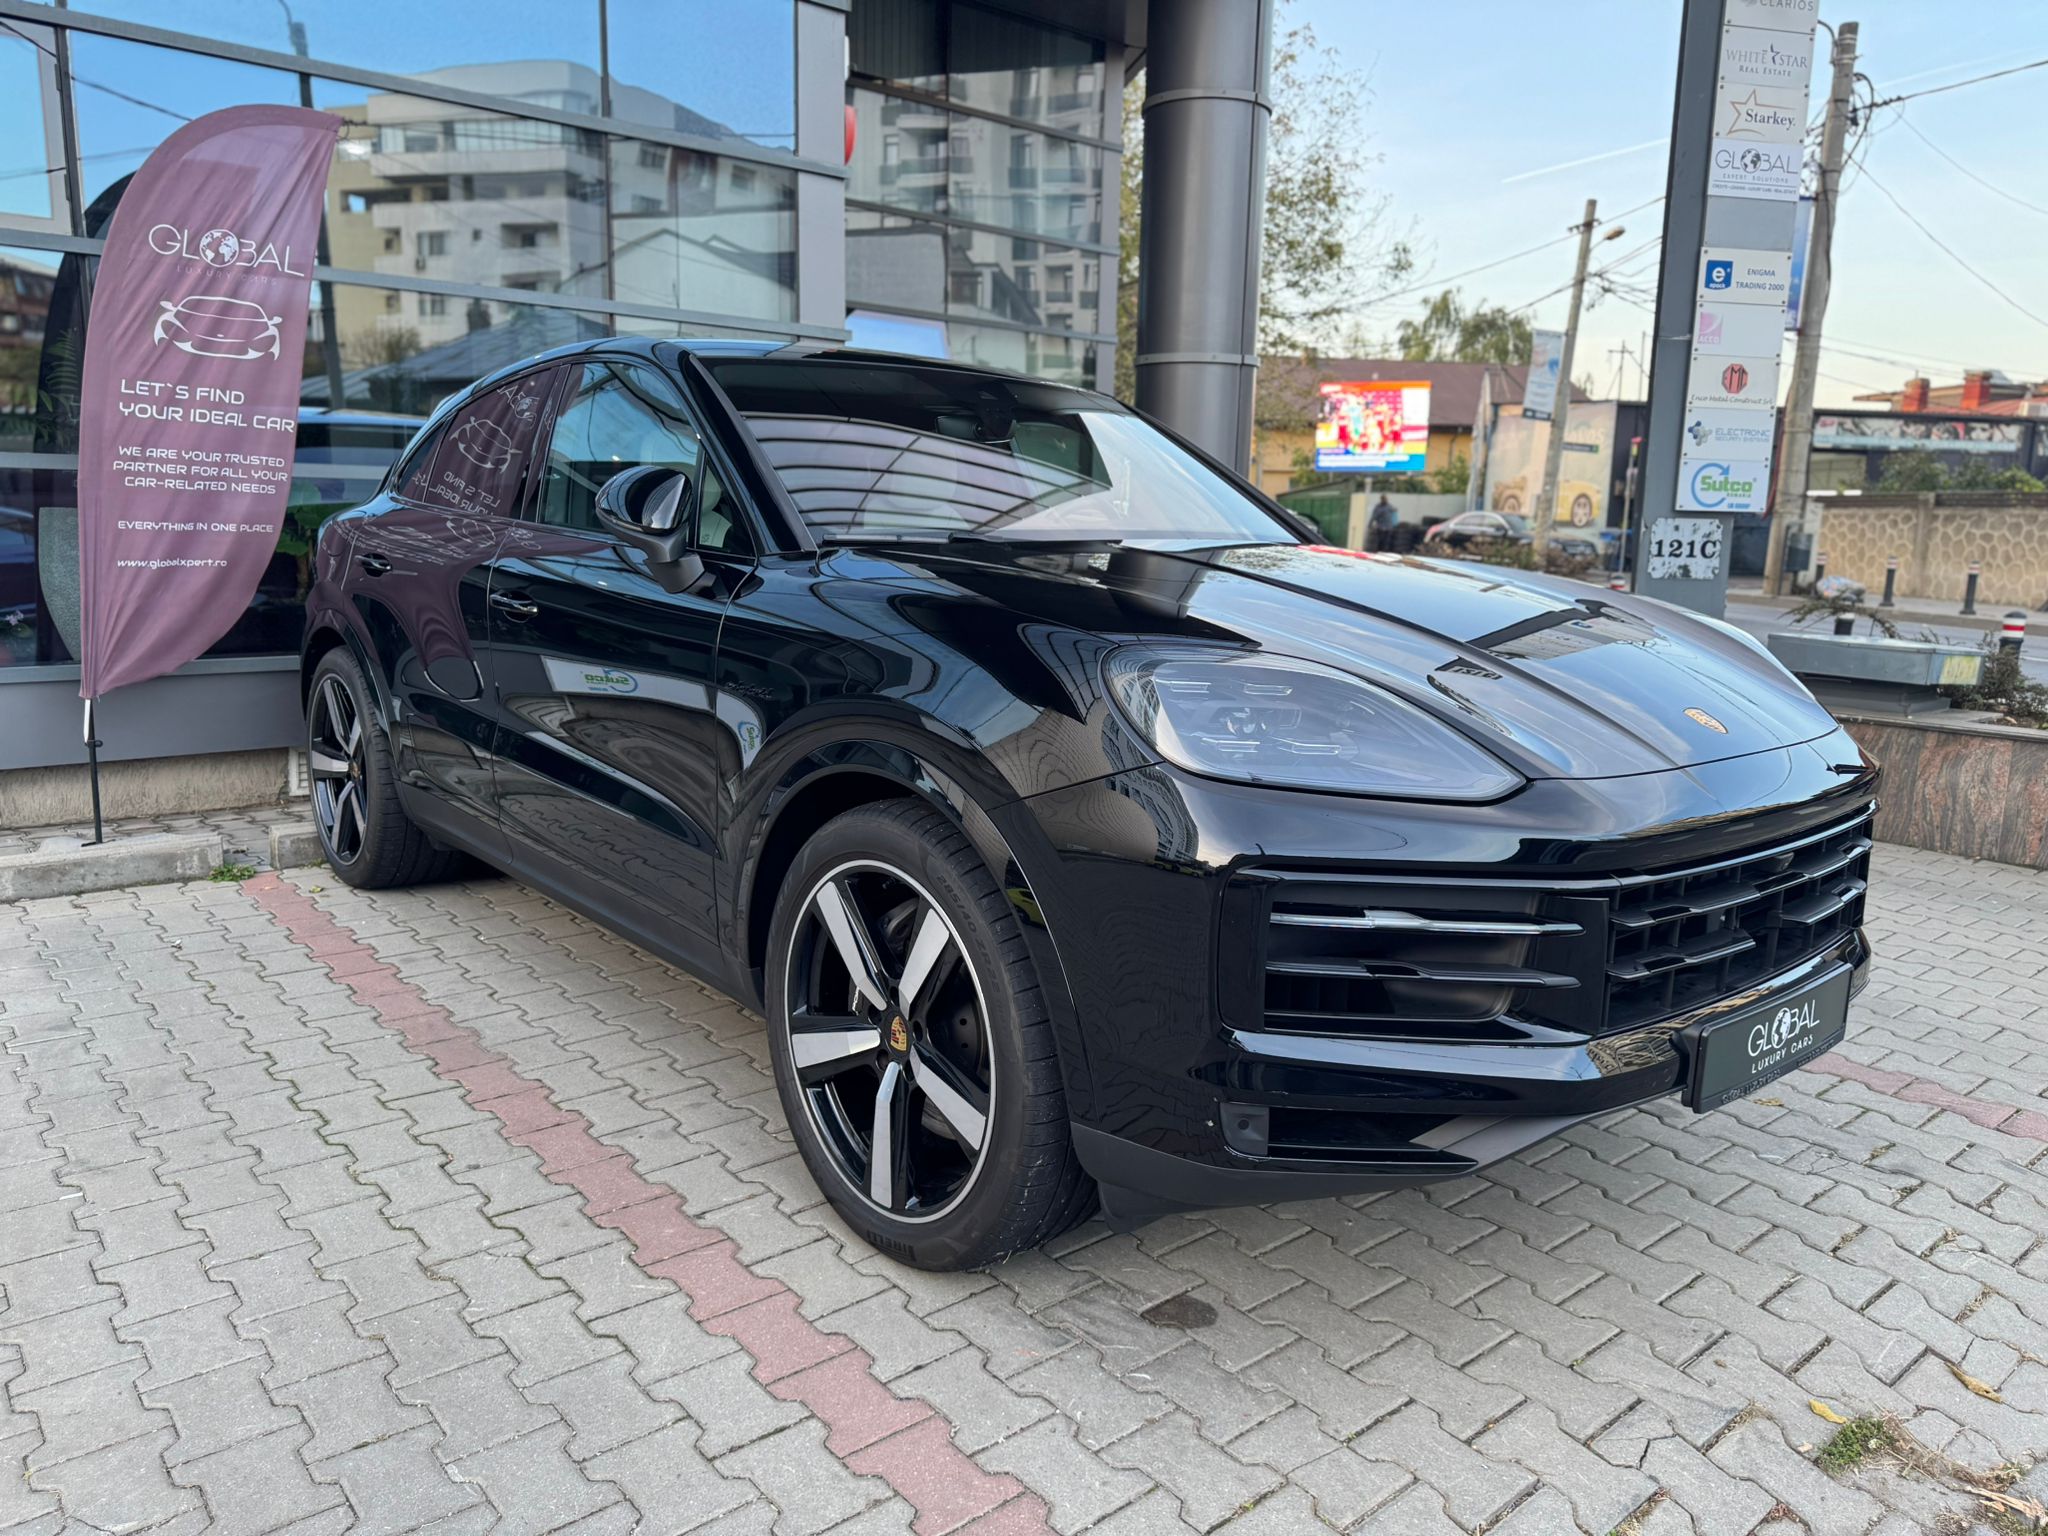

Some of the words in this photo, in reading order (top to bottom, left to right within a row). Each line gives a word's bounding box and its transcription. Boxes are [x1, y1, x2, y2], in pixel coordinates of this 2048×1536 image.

[1727, 49, 1767, 64] WHITE
[1779, 54, 1808, 68] STAR
[1715, 148, 1798, 174] GLOBAL
[149, 224, 304, 276] GLOBAL
[1747, 268, 1776, 277] ENIGMA
[1736, 282, 1767, 290] TRADING
[1768, 283, 1785, 291] 2000
[196, 387, 245, 405] FIND
[119, 402, 183, 421] YOUR
[190, 408, 247, 427] IDEAL
[253, 415, 295, 432] CAR
[119, 445, 142, 456] WE
[146, 448, 177, 459] ARE
[182, 450, 222, 462] YOUR
[225, 453, 285, 467] TRUSTED
[113, 461, 187, 474] PARTNER
[191, 465, 221, 477] FOR
[221, 467, 248, 479] ALL
[251, 469, 288, 482] YOUR
[125, 477, 227, 491] CAR-RELATED
[231, 483, 276, 494] NEEDS
[1700, 475, 1753, 492] Sutco
[118, 520, 194, 531] EVERYTHING
[196, 522, 207, 531] IN
[211, 522, 237, 532] ONE
[240, 524, 274, 533] PLACE
[1654, 539, 1717, 559] 121C
[117, 558, 227, 570] www.globalxpert.ro
[1748, 1000, 1820, 1056] GLOBAL
[1752, 1048, 1786, 1074] LUXURY
[1791, 1034, 1814, 1054] CARS
